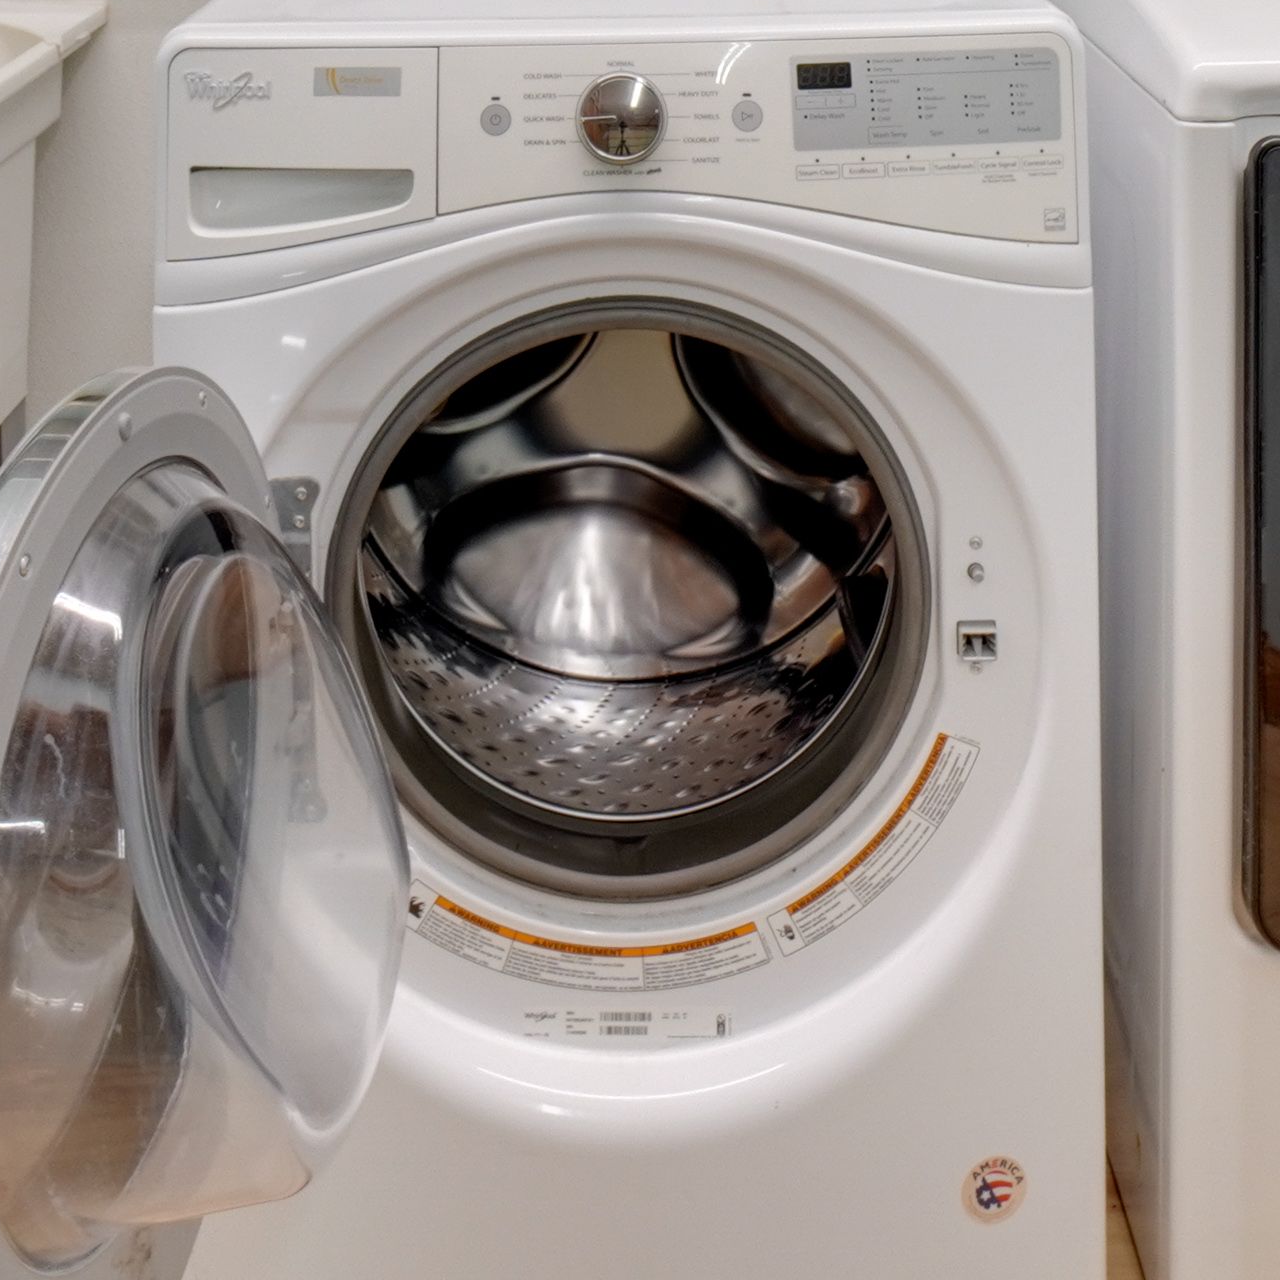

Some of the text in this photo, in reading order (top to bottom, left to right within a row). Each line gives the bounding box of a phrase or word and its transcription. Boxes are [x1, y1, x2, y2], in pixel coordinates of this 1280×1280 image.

[799, 876, 839, 908] WARNING
[455, 906, 500, 933] WARNING
[542, 939, 621, 956] AVERTISSEMENT
[668, 930, 738, 954] ADVERTENCIA
[972, 1159, 1024, 1185] AMERICA
